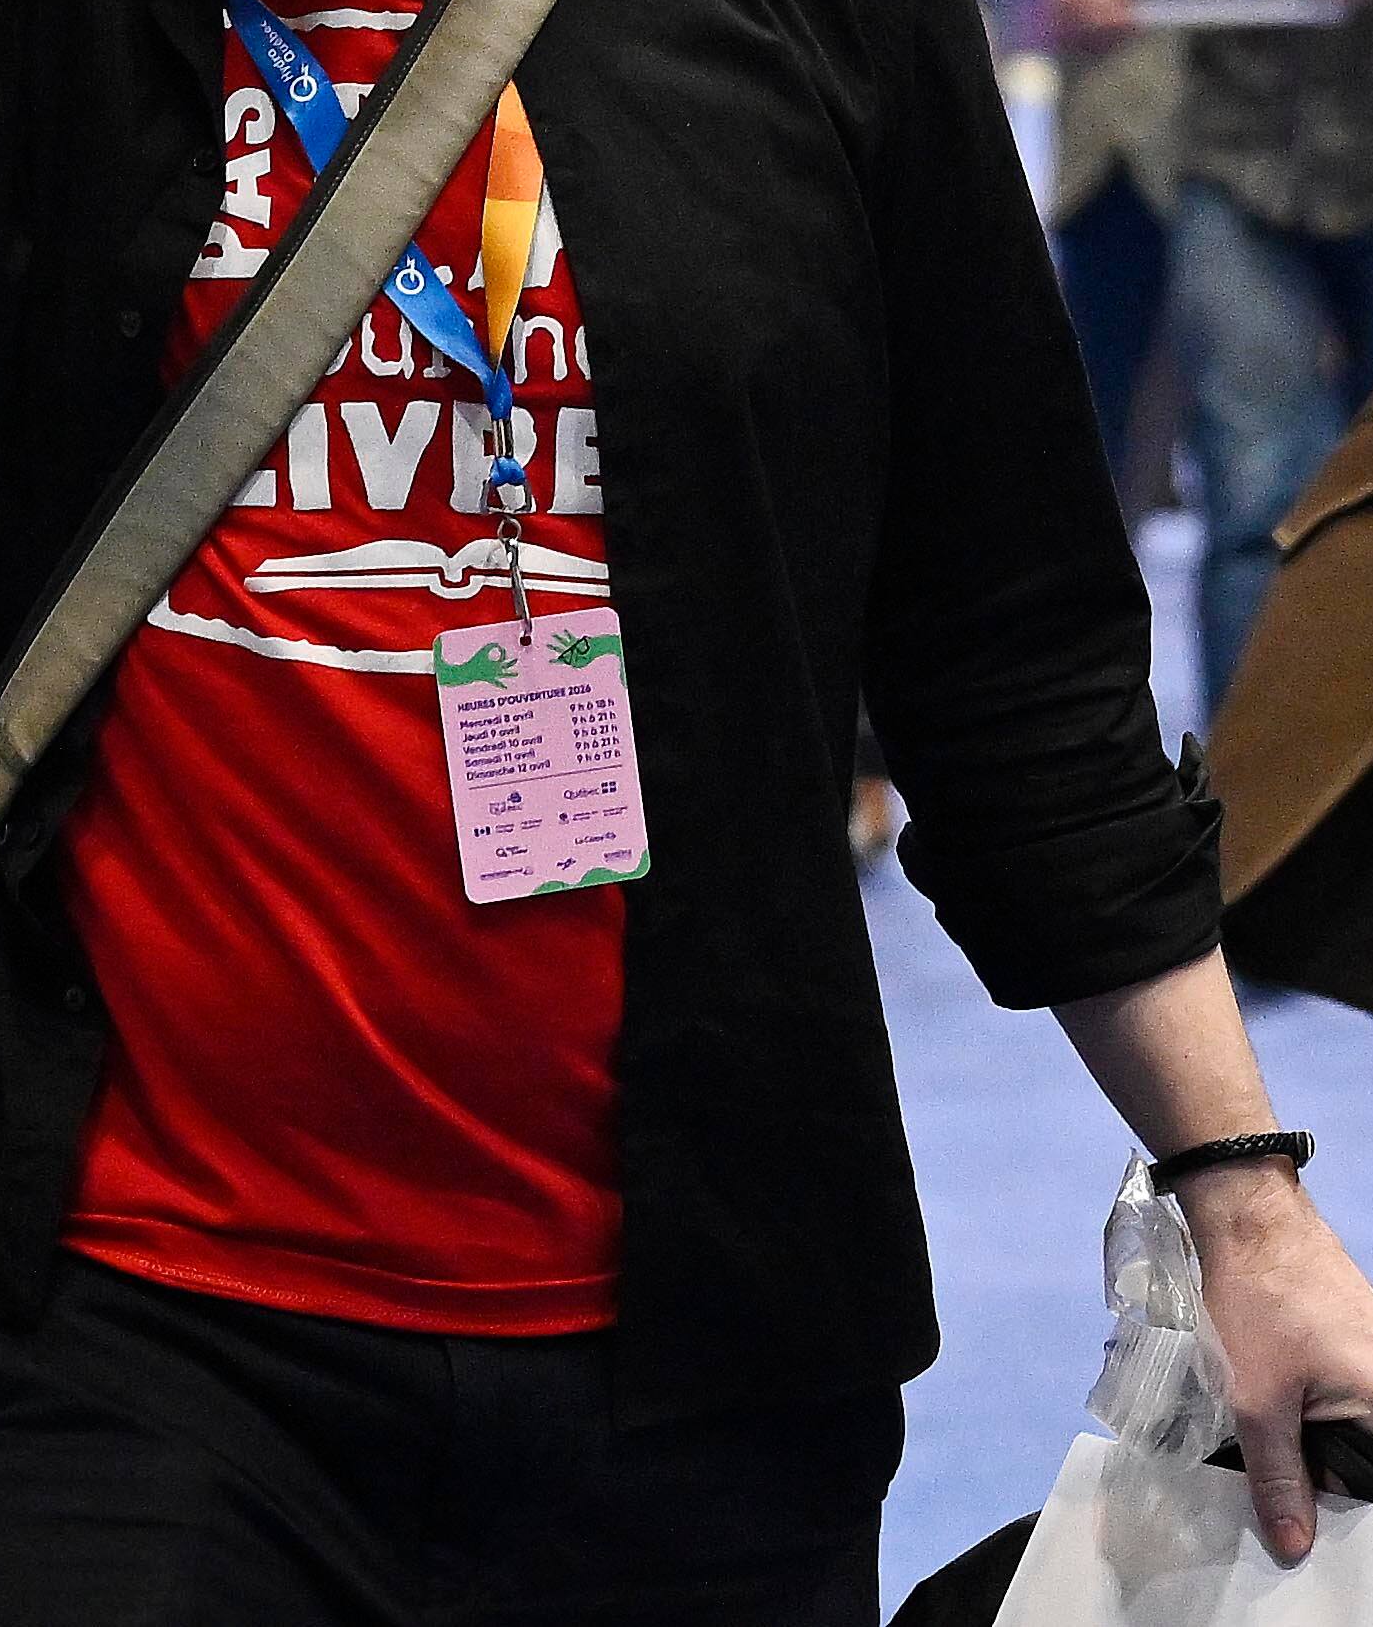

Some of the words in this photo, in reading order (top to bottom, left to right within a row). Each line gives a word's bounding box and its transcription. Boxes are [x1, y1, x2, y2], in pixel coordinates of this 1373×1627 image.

[268, 48, 295, 83] Hydro
[190, 87, 275, 278] PAS
[458, 698, 495, 712] HEURES
[498, 688, 565, 706] D'OUVERTURE
[568, 684, 592, 696] 2026
[460, 716, 502, 729] Mercredi
[513, 711, 534, 722] avril
[463, 730, 488, 742] Jeudi
[499, 725, 520, 737] avril
[463, 741, 506, 754] Vendredi
[509, 738, 519, 748] 10
[522, 735, 542, 746] avril
[465, 754, 502, 767] Samedi
[514, 748, 536, 760] avril
[467, 766, 515, 780] Dimanche
[517, 763, 527, 773] 12
[529, 759, 550, 771] avril
